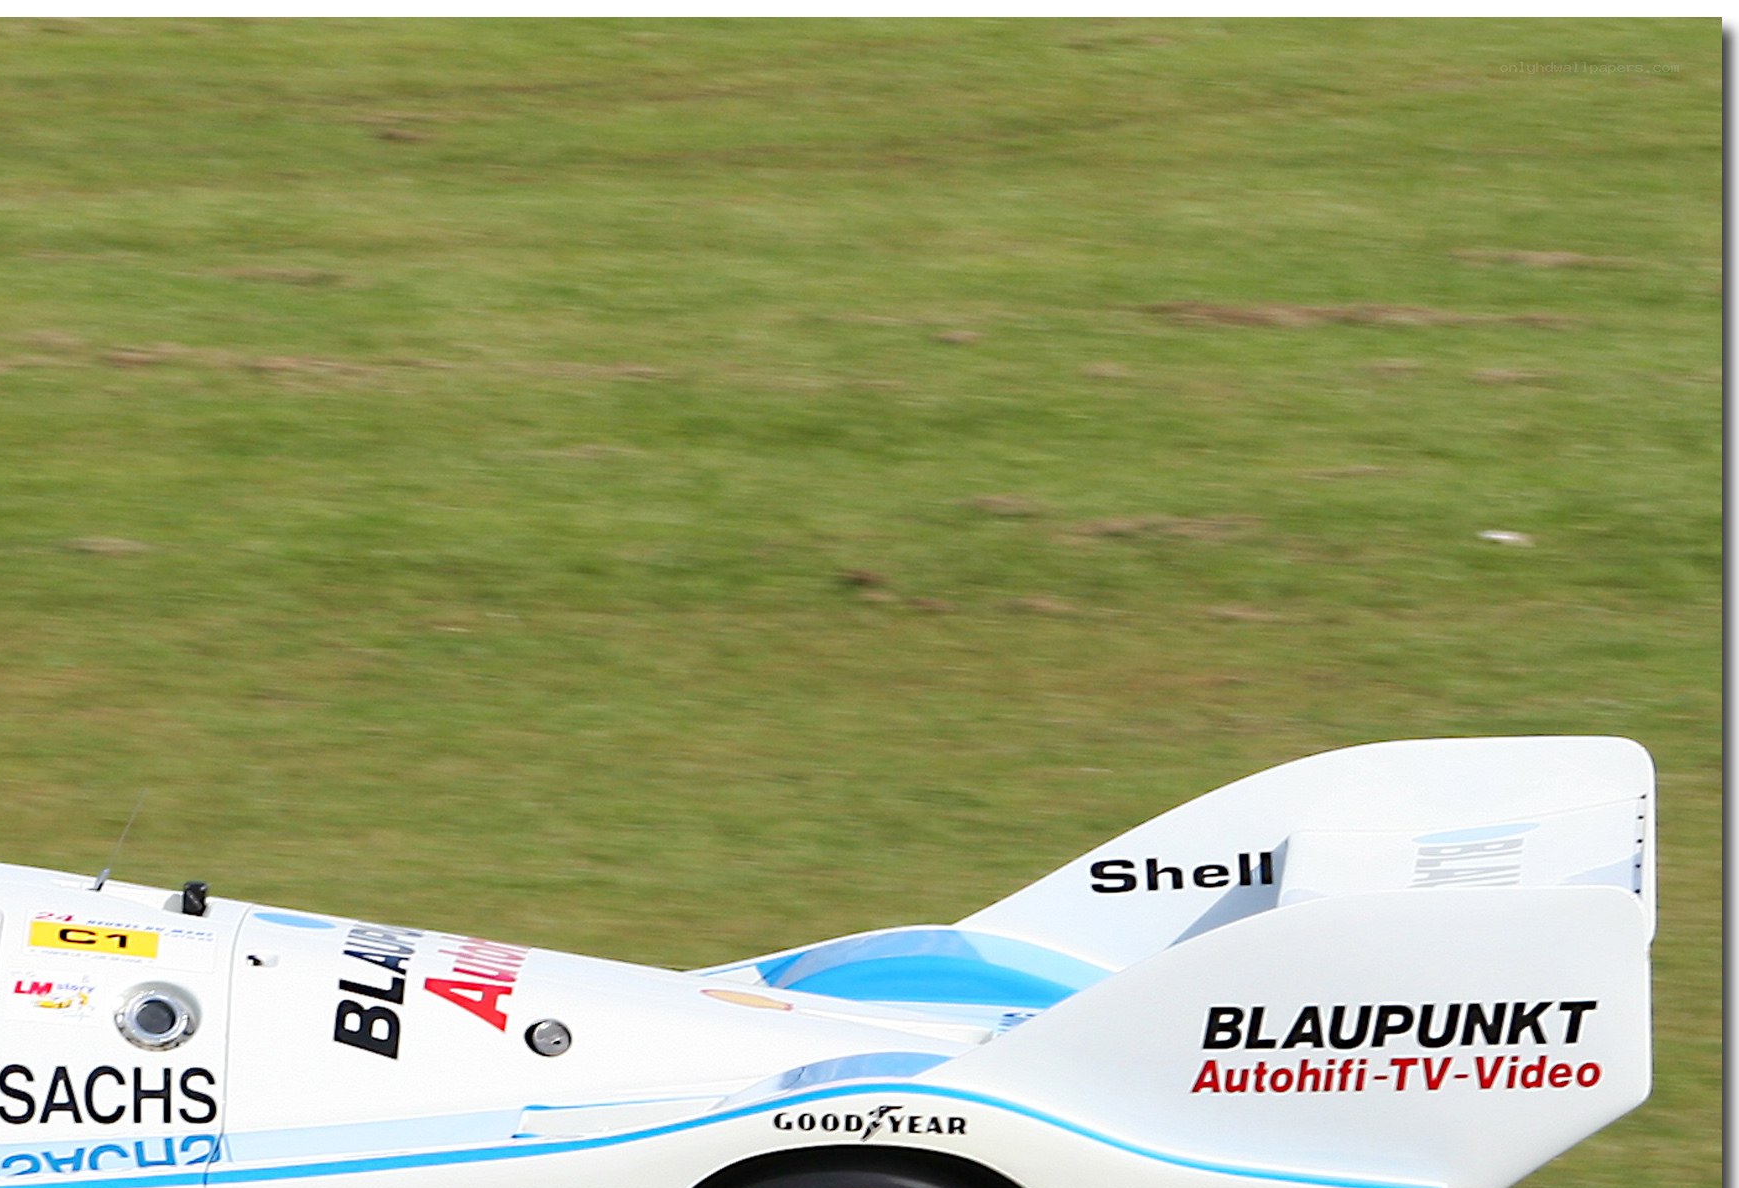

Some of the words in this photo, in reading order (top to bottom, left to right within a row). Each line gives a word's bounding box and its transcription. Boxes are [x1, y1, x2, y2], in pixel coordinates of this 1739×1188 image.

[1090, 852, 1274, 893] Shell
[59, 928, 128, 949] C1
[1203, 1001, 1597, 1049] BLAUPUNKT
